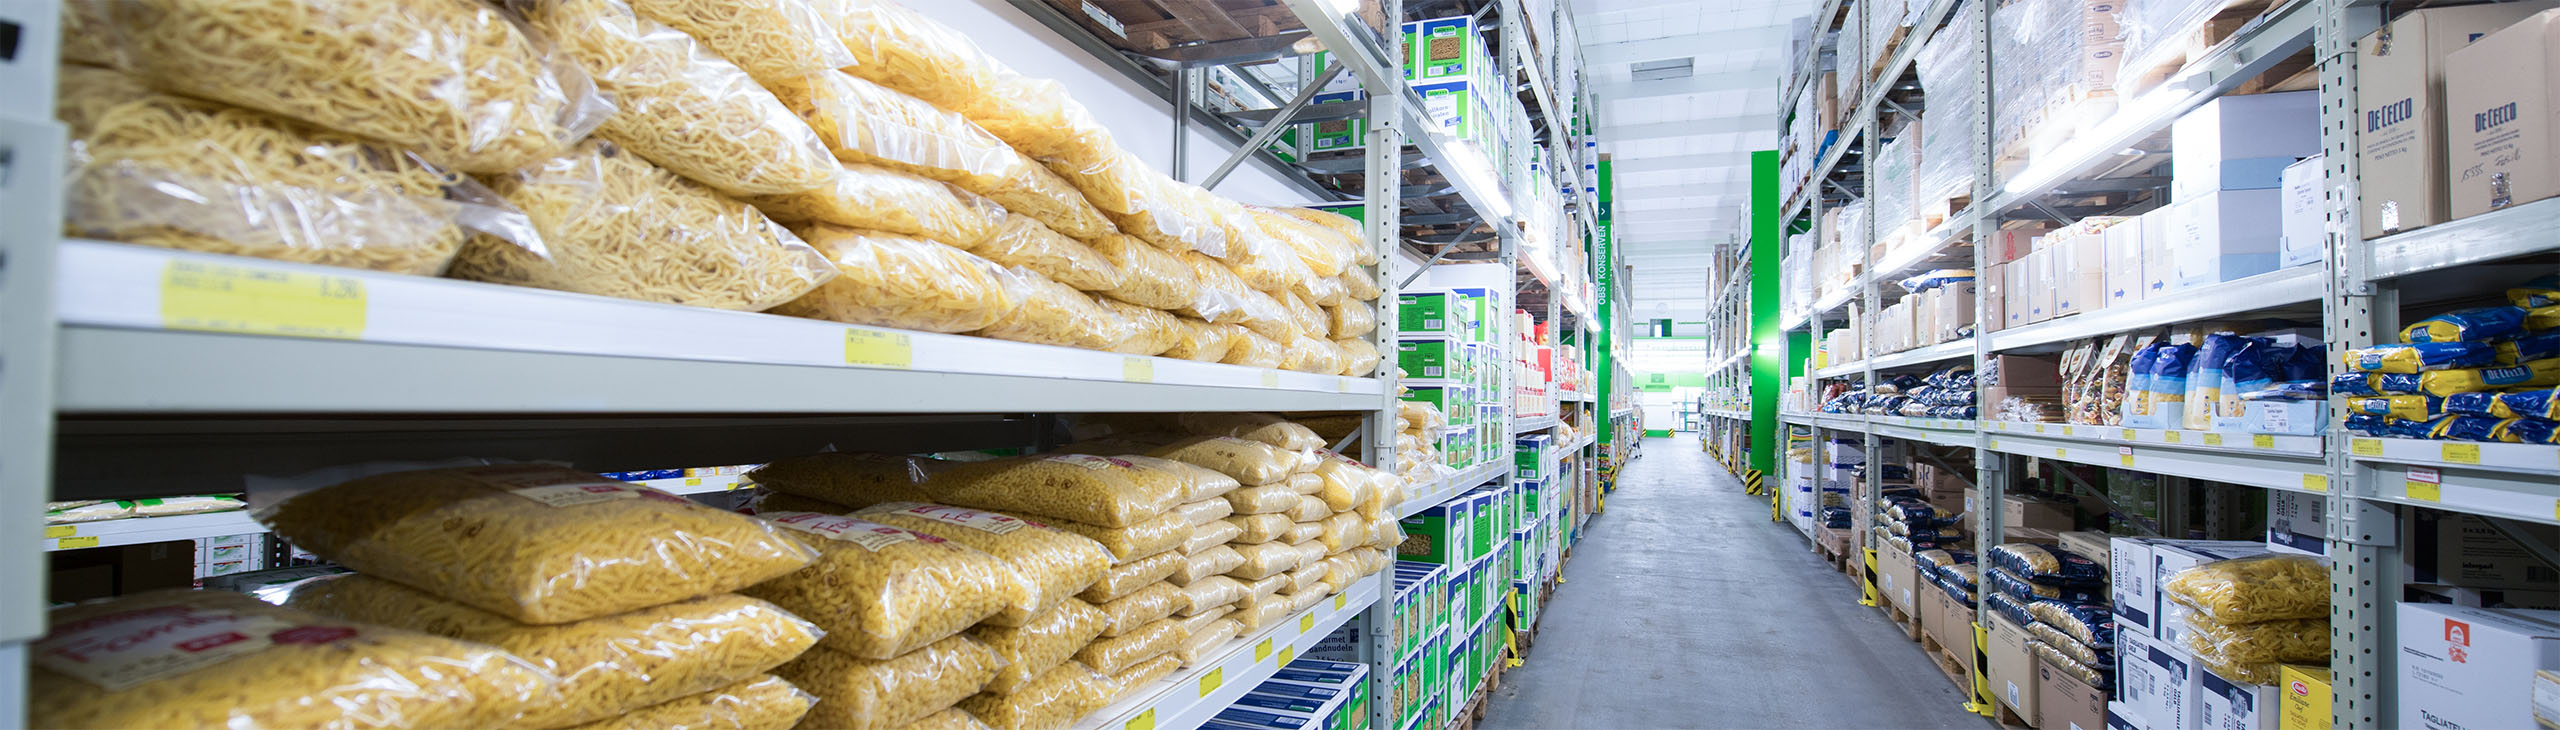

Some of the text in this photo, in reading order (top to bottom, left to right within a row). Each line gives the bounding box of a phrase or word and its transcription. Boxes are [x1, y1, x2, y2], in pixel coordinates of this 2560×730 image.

[2367, 97, 2412, 133] DE CECCO
[2474, 102, 2517, 133] DE CECCO
[1598, 225, 1606, 305] OBST KONSERVEN
